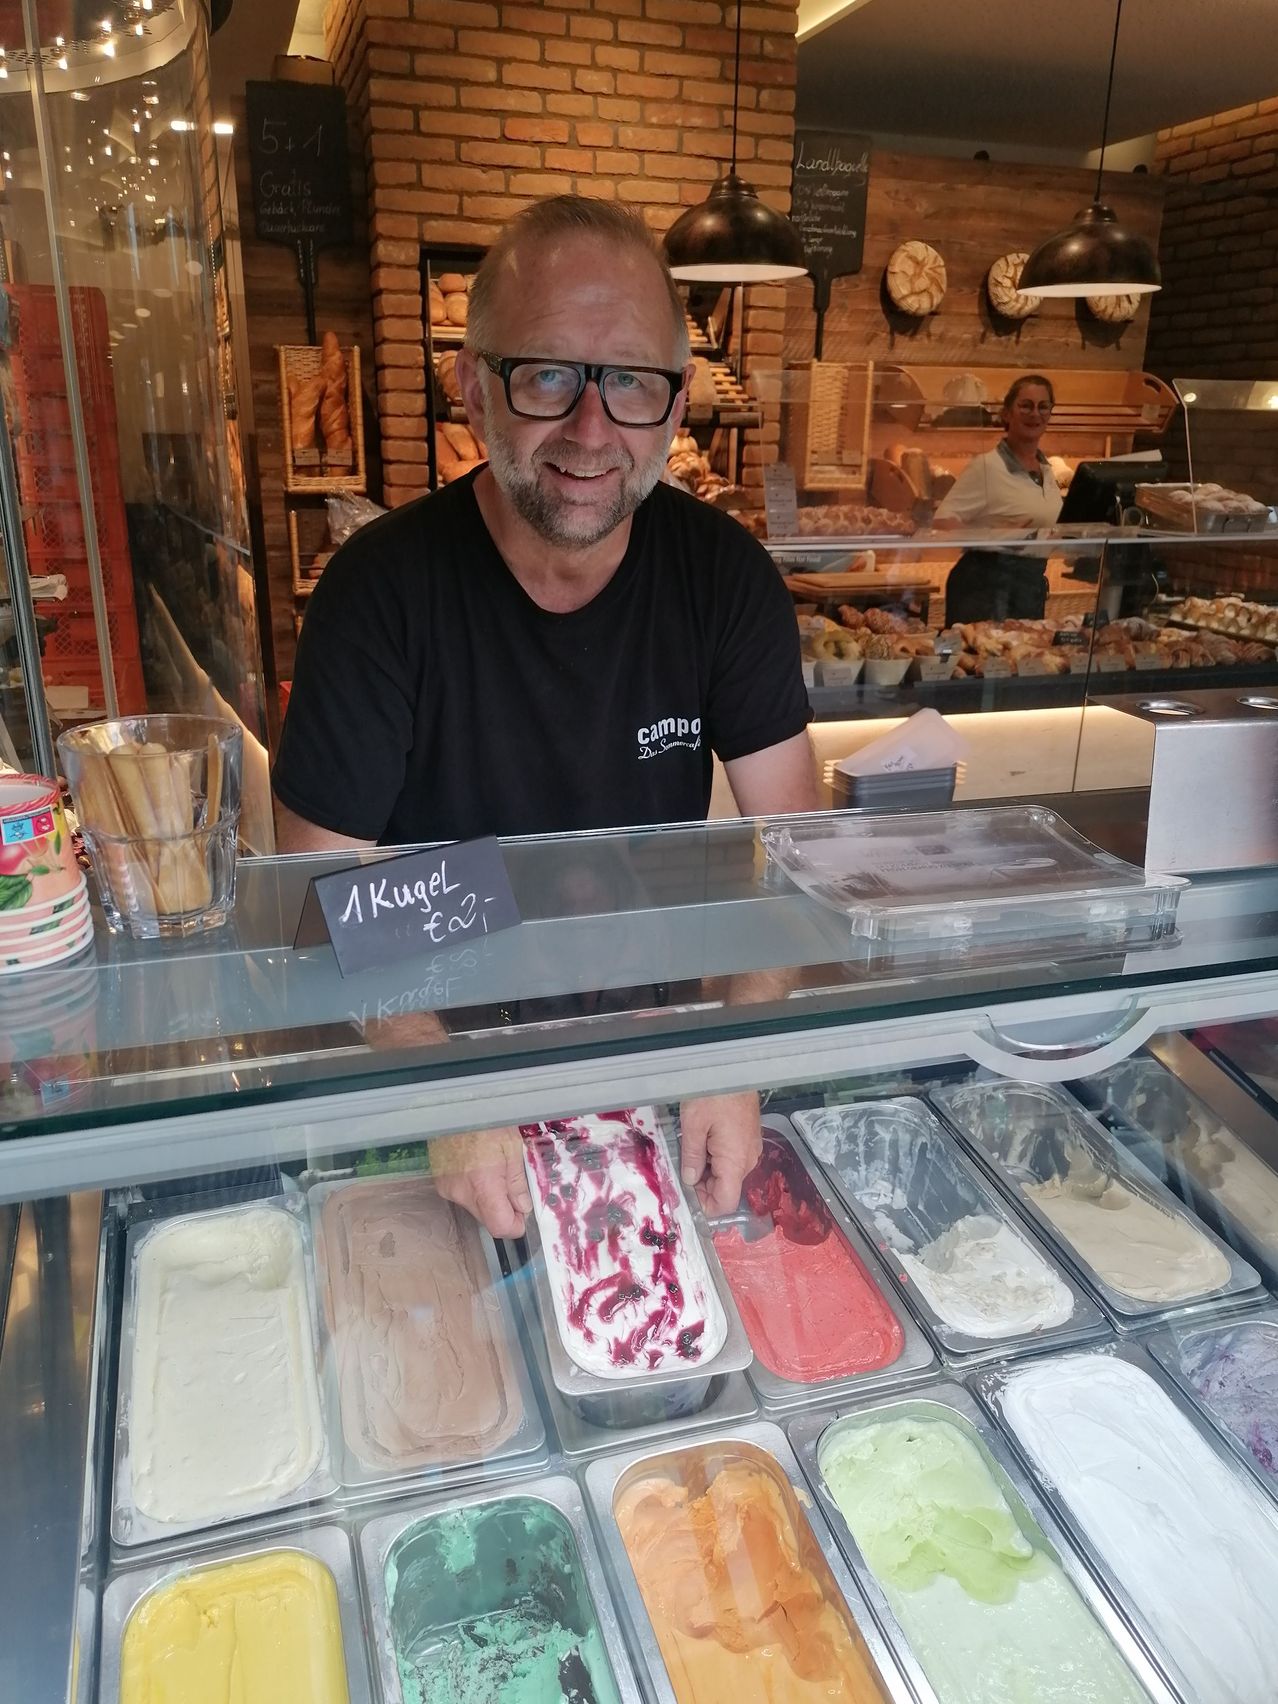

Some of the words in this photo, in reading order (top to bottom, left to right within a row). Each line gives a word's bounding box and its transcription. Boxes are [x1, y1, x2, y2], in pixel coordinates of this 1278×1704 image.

[259, 168, 312, 198] Gratis
[637, 717, 701, 745] campo
[637, 746, 658, 760] Das
[338, 884, 363, 924] 1
